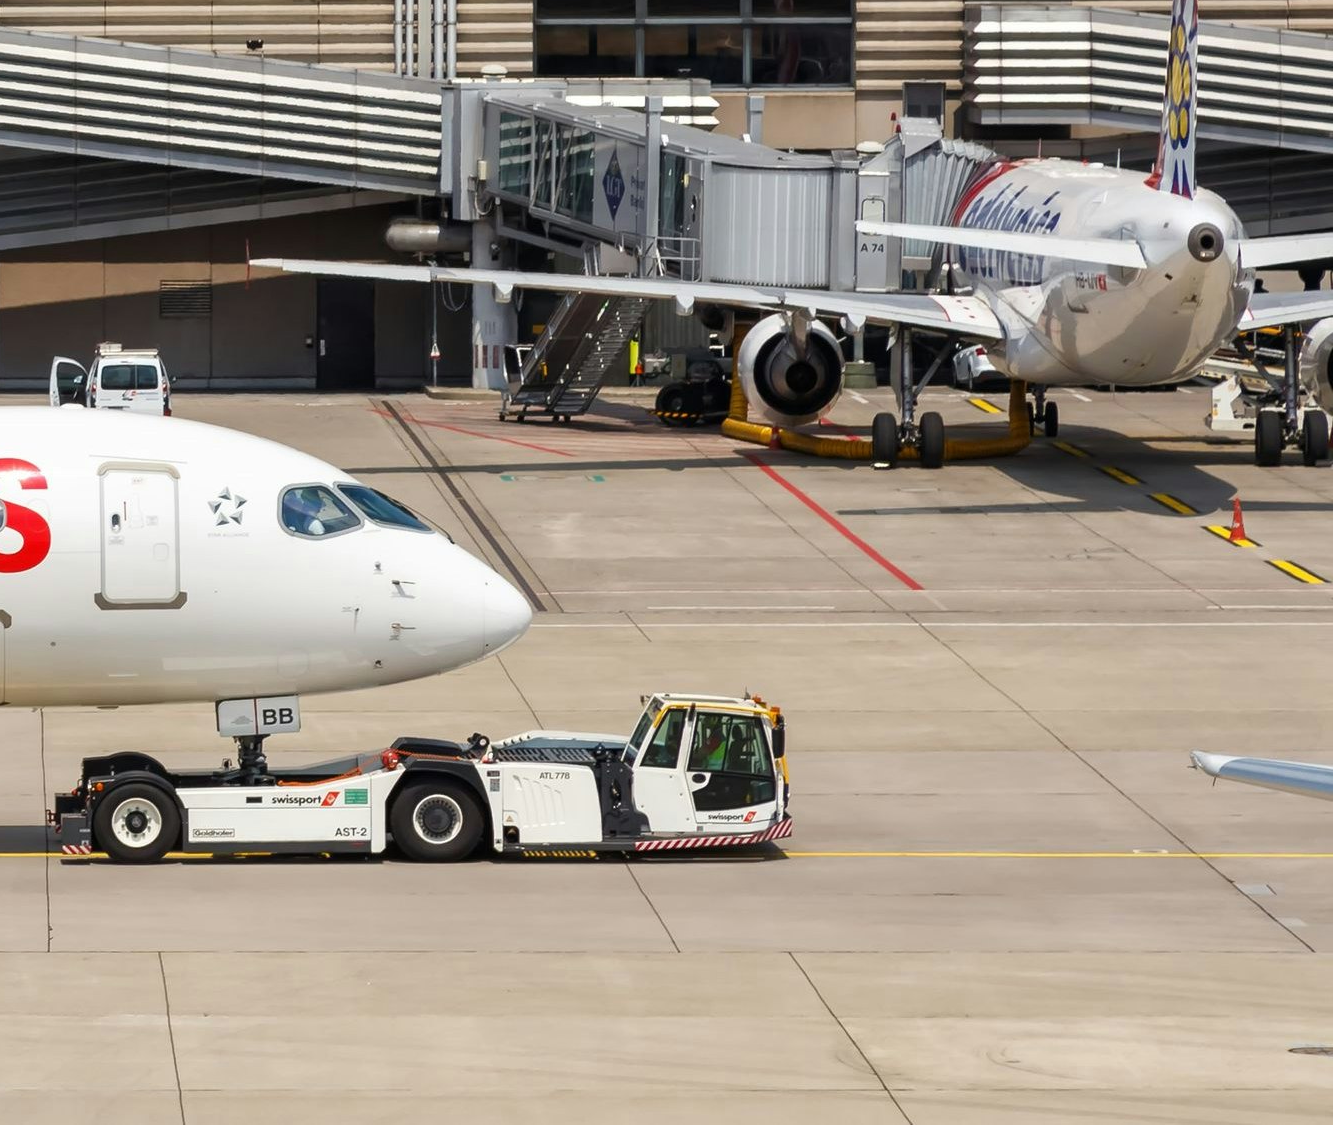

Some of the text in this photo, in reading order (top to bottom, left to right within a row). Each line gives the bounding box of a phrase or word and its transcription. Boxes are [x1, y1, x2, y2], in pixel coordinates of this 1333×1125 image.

[861, 243, 868, 252] A
[262, 708, 294, 725] BB
[271, 794, 322, 806] swissport
[708, 813, 744, 821] swissport
[335, 827, 367, 837] AST-2
